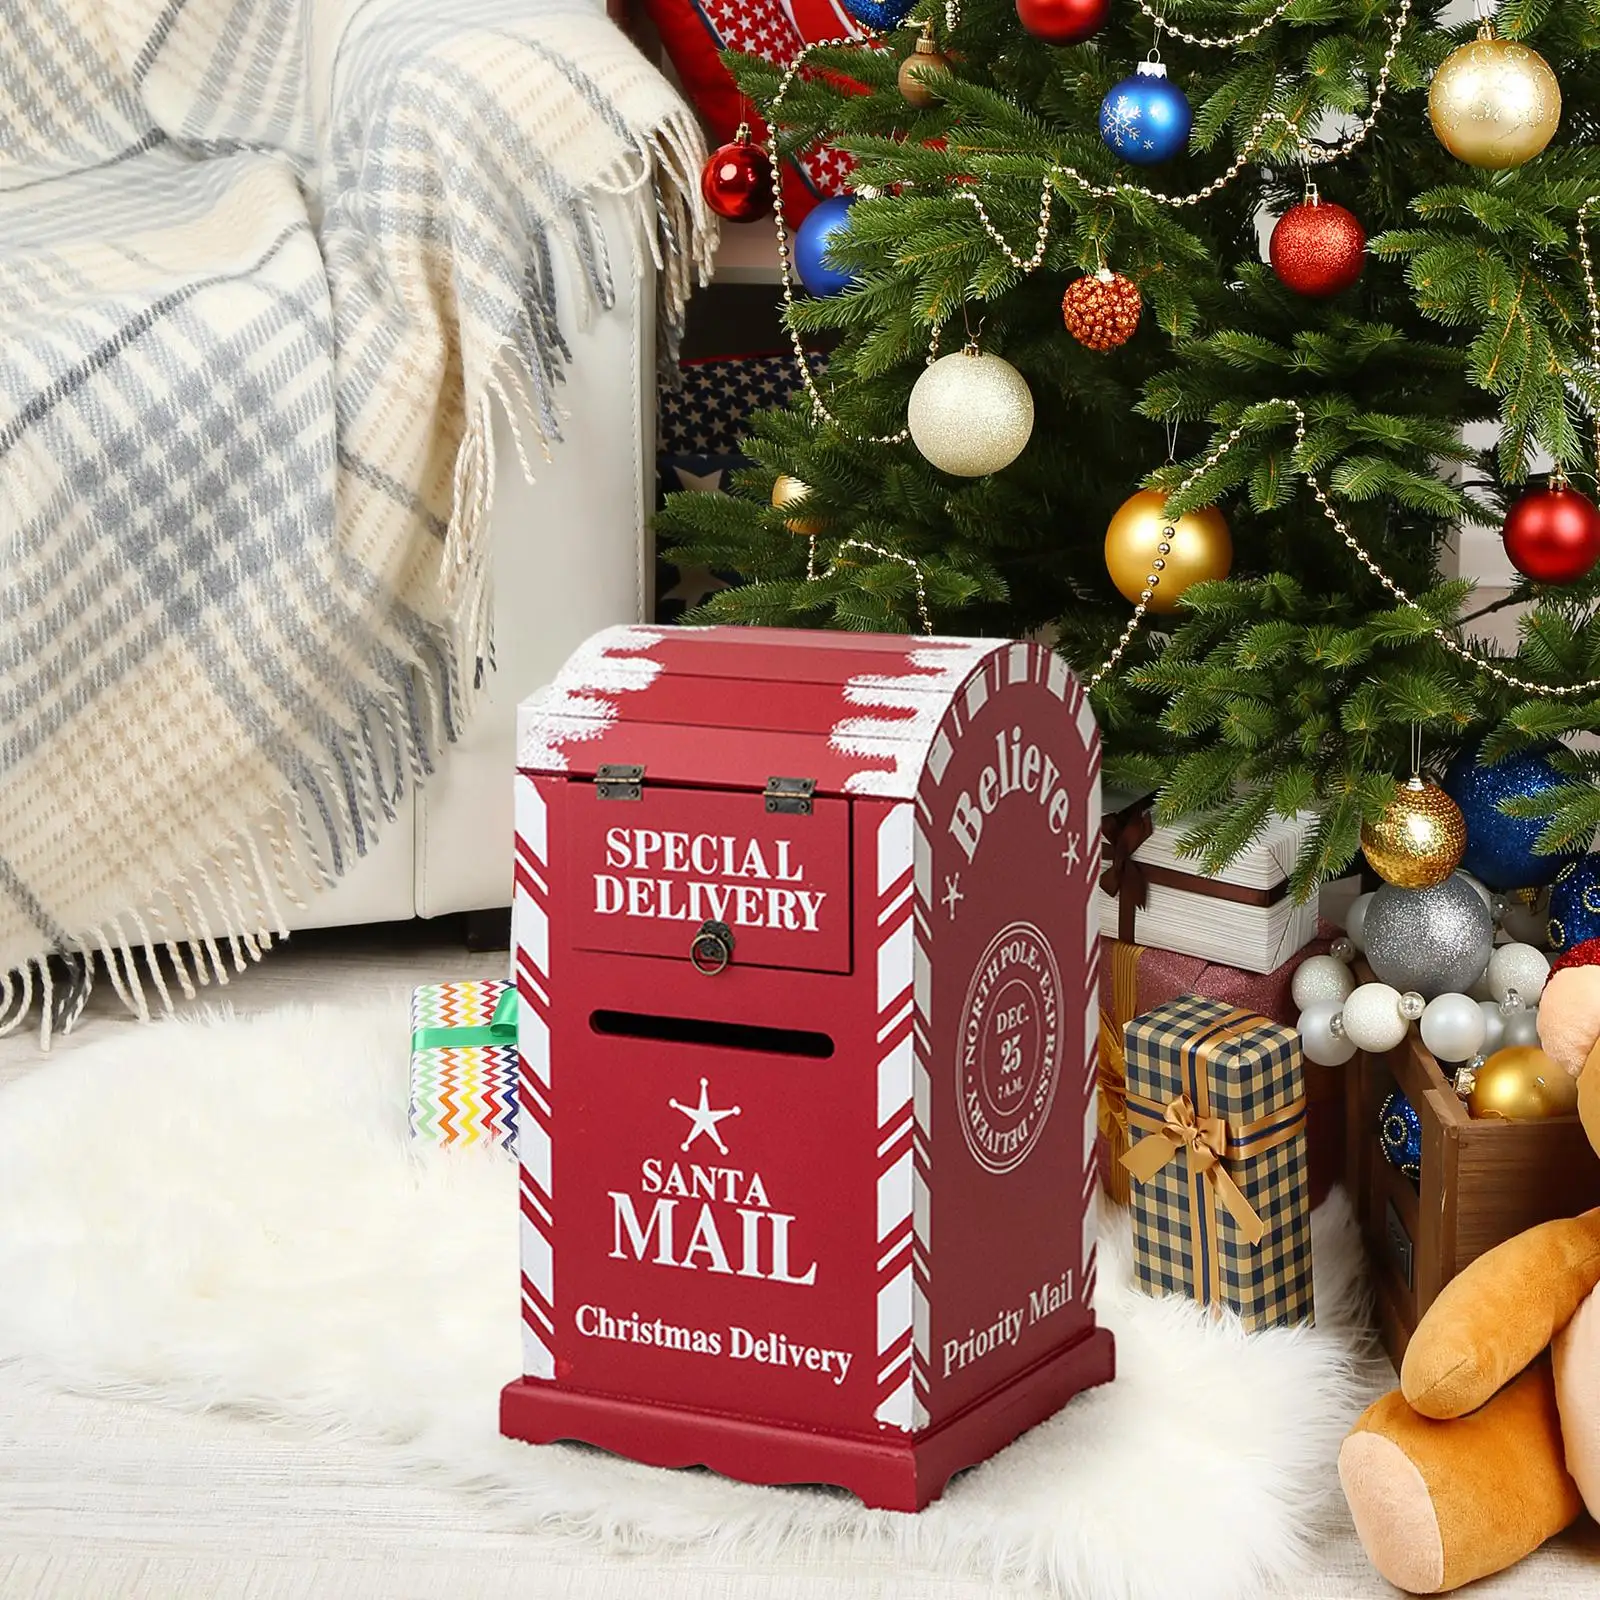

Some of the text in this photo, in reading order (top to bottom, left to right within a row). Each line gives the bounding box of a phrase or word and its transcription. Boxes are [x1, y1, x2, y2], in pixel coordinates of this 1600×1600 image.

[948, 727, 1070, 862] Believe
[605, 827, 803, 881] SPECIAL
[593, 875, 827, 932] DELIVERY
[964, 959, 999, 1067] NORTH
[996, 1003, 1031, 1035] DEC.
[1001, 1034, 1022, 1076] 25
[965, 1091, 1028, 1154] DELIVERY
[641, 1158, 770, 1208] SANTA
[608, 1191, 818, 1287] MAIL
[575, 1304, 853, 1385] Christmas Delivery
[943, 1270, 1074, 1378] Priority Mail
